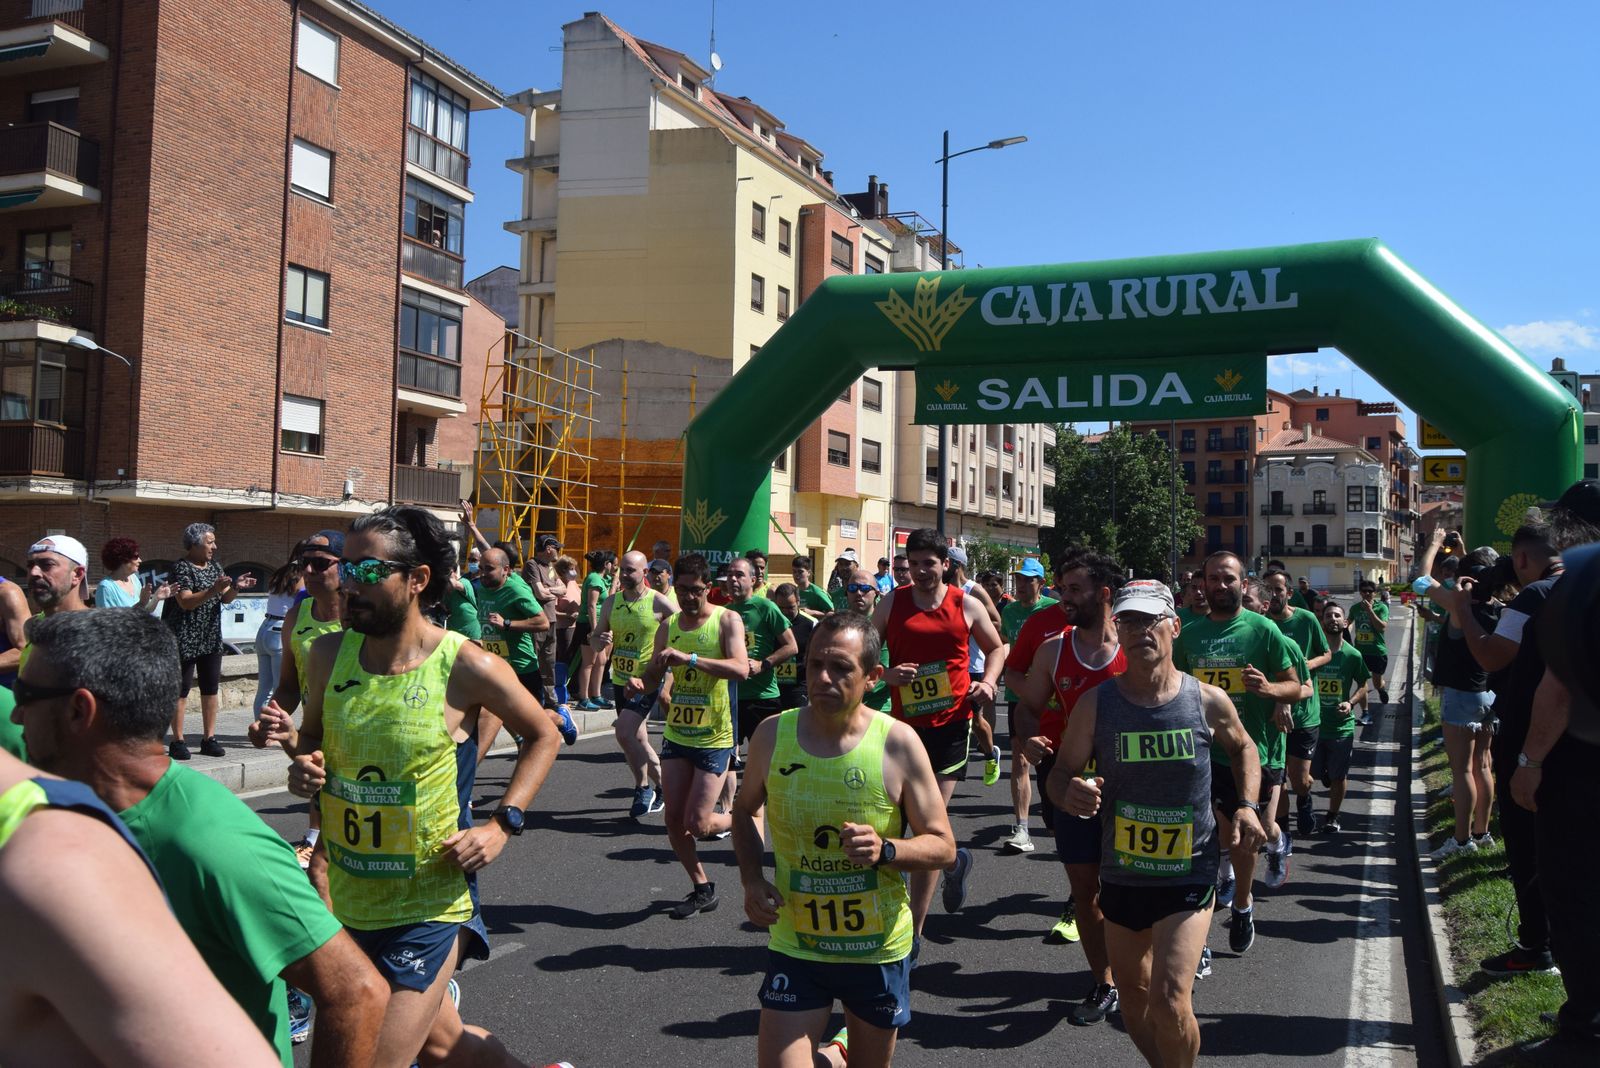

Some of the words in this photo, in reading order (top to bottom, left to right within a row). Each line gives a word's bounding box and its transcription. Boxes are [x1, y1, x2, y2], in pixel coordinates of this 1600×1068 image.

[980, 281, 1104, 326] CAJA
[1108, 267, 1298, 320] RURAL
[977, 372, 1193, 411] SALIDA
[1224, 393, 1252, 401] RURAL
[614, 657, 634, 672] 138
[911, 677, 938, 699] 99
[1204, 671, 1231, 690] 75
[672, 706, 705, 725] 207
[1122, 735, 1129, 760] I
[1139, 731, 1194, 759] RUN
[343, 782, 401, 795] FUNDACION
[343, 790, 362, 803] CAJA
[366, 795, 401, 804] RURAL
[1137, 807, 1183, 818] FUNDACION
[1157, 816, 1183, 824] RURAL
[343, 807, 382, 849] 61
[1124, 824, 1181, 855] 197
[343, 856, 365, 871] CAJA
[368, 861, 409, 871] RURAL
[800, 855, 864, 872] Adarsa
[1157, 863, 1185, 872] RURAL
[813, 874, 866, 886] FUNDACION
[837, 883, 867, 893] RURAL
[804, 899, 865, 931] 115
[845, 941, 880, 951] RURAL
[763, 989, 797, 1002] Adarsa
